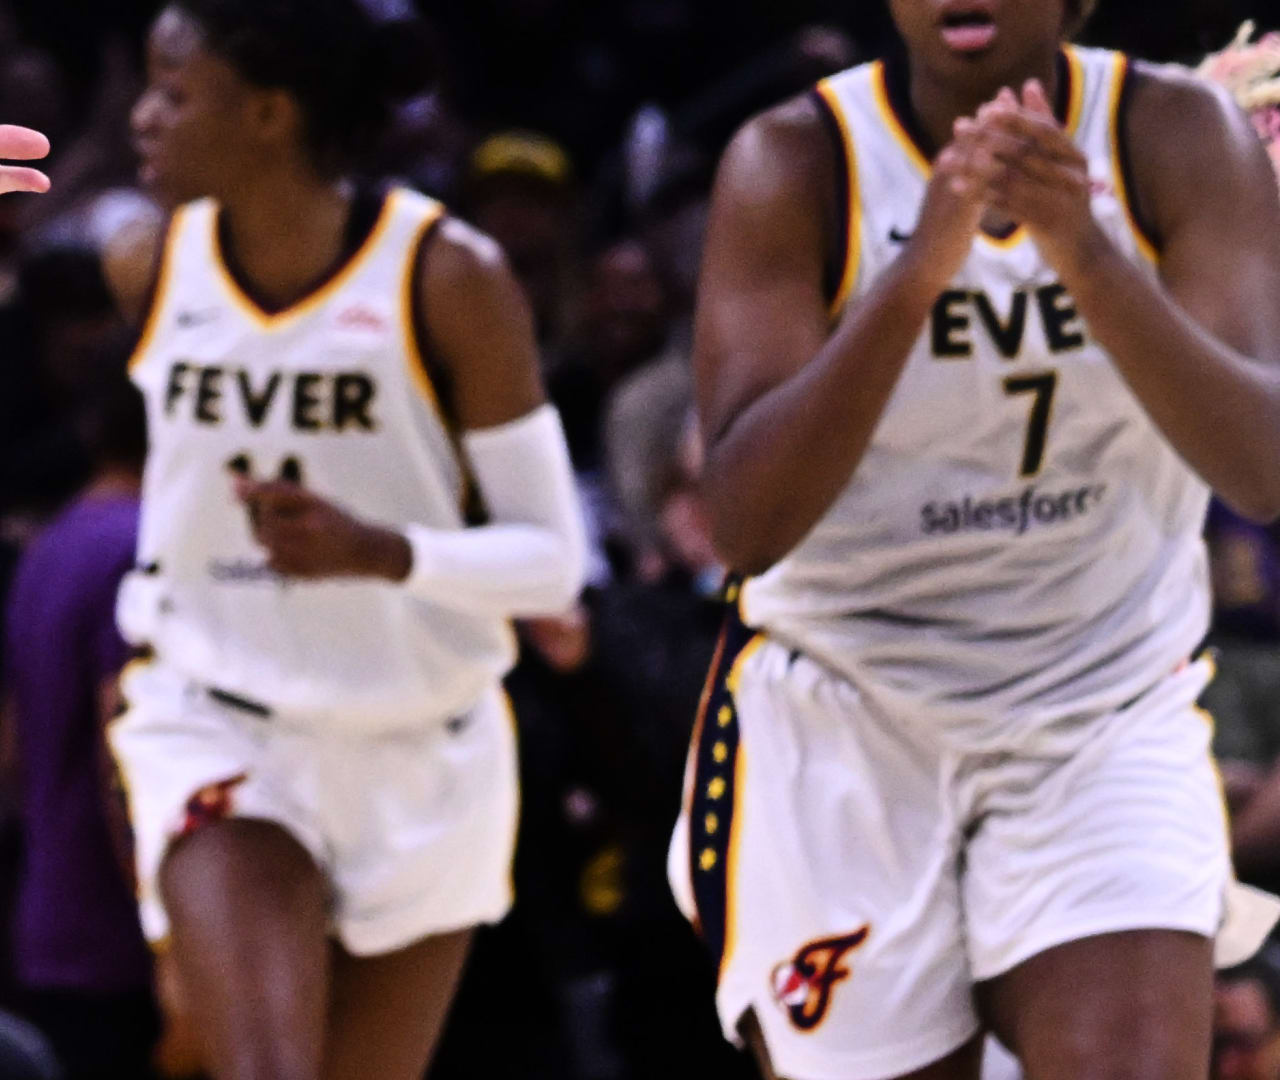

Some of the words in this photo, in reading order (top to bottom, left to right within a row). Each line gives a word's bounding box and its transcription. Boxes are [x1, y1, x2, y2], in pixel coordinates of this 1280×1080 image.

[931, 283, 1085, 360] EVE
[163, 360, 380, 432] FEVER
[1002, 369, 1059, 480] 7
